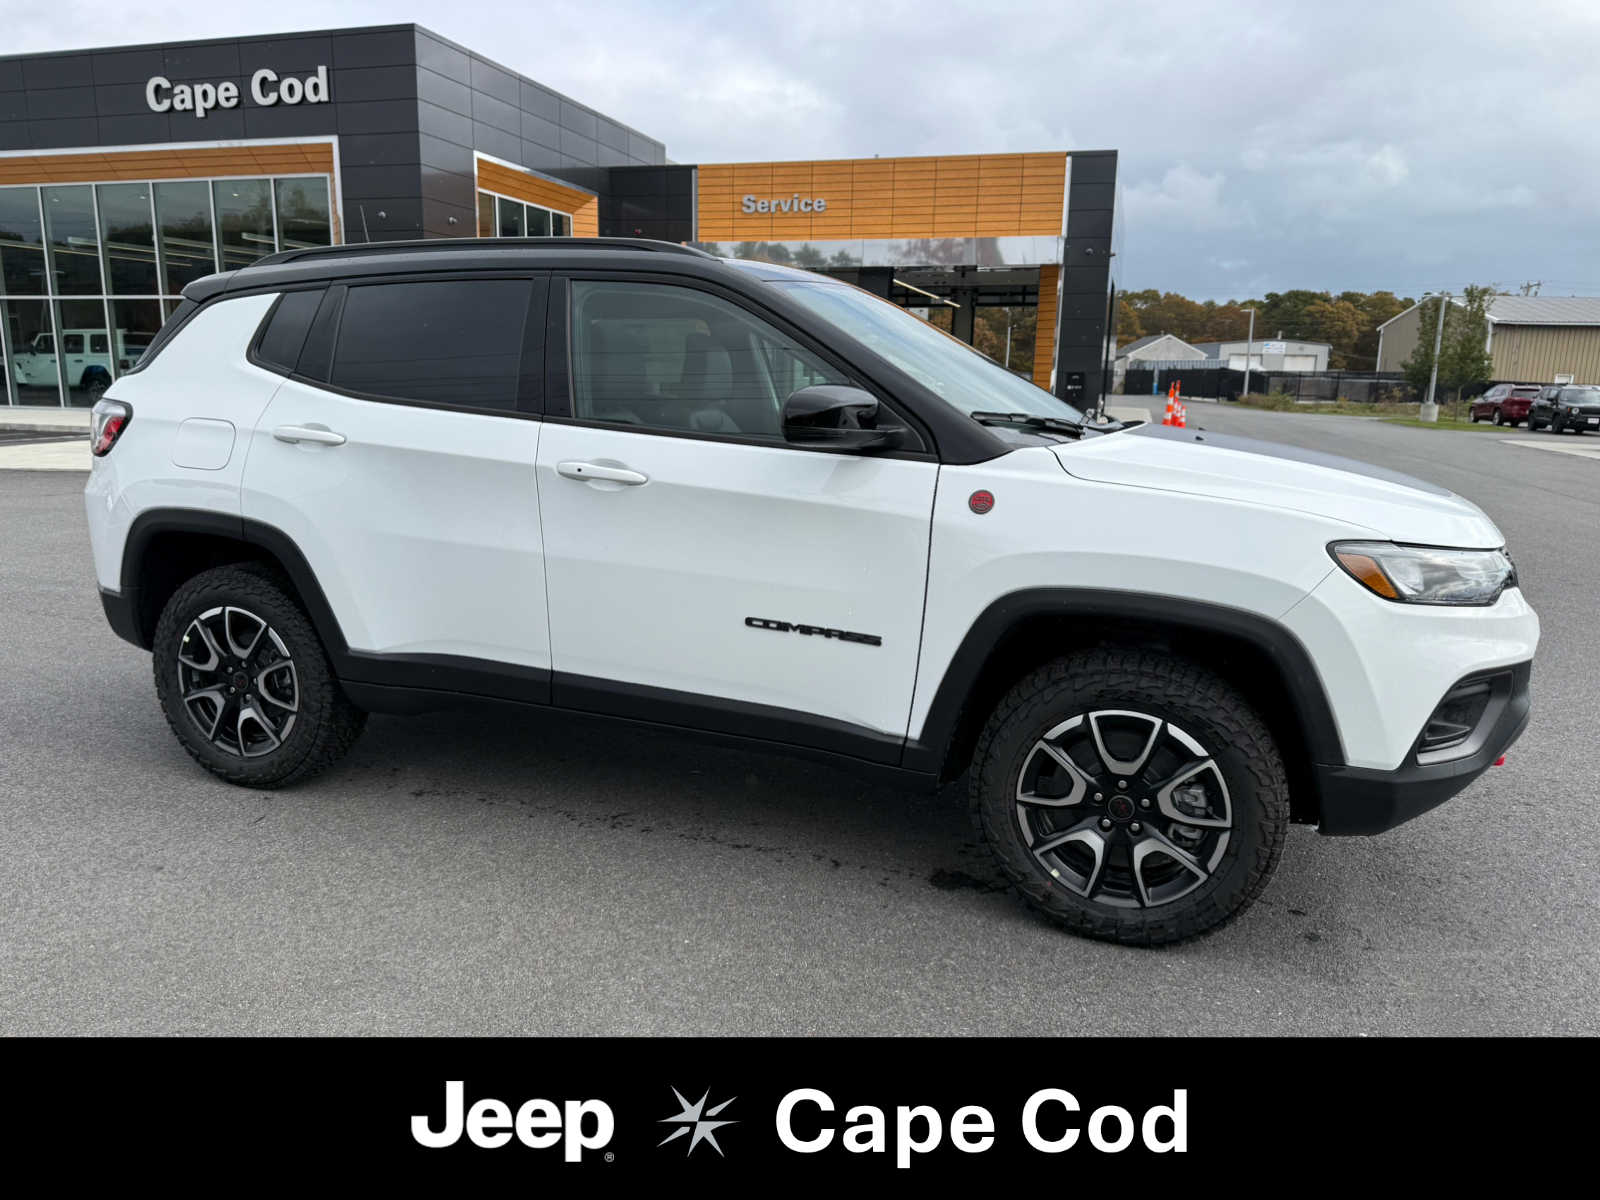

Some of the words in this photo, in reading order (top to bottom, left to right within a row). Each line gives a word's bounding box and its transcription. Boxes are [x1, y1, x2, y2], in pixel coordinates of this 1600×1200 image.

[146, 76, 239, 118] Cape
[251, 65, 329, 106] Cod
[742, 194, 826, 213] Service
[745, 616, 882, 647] COMPASS
